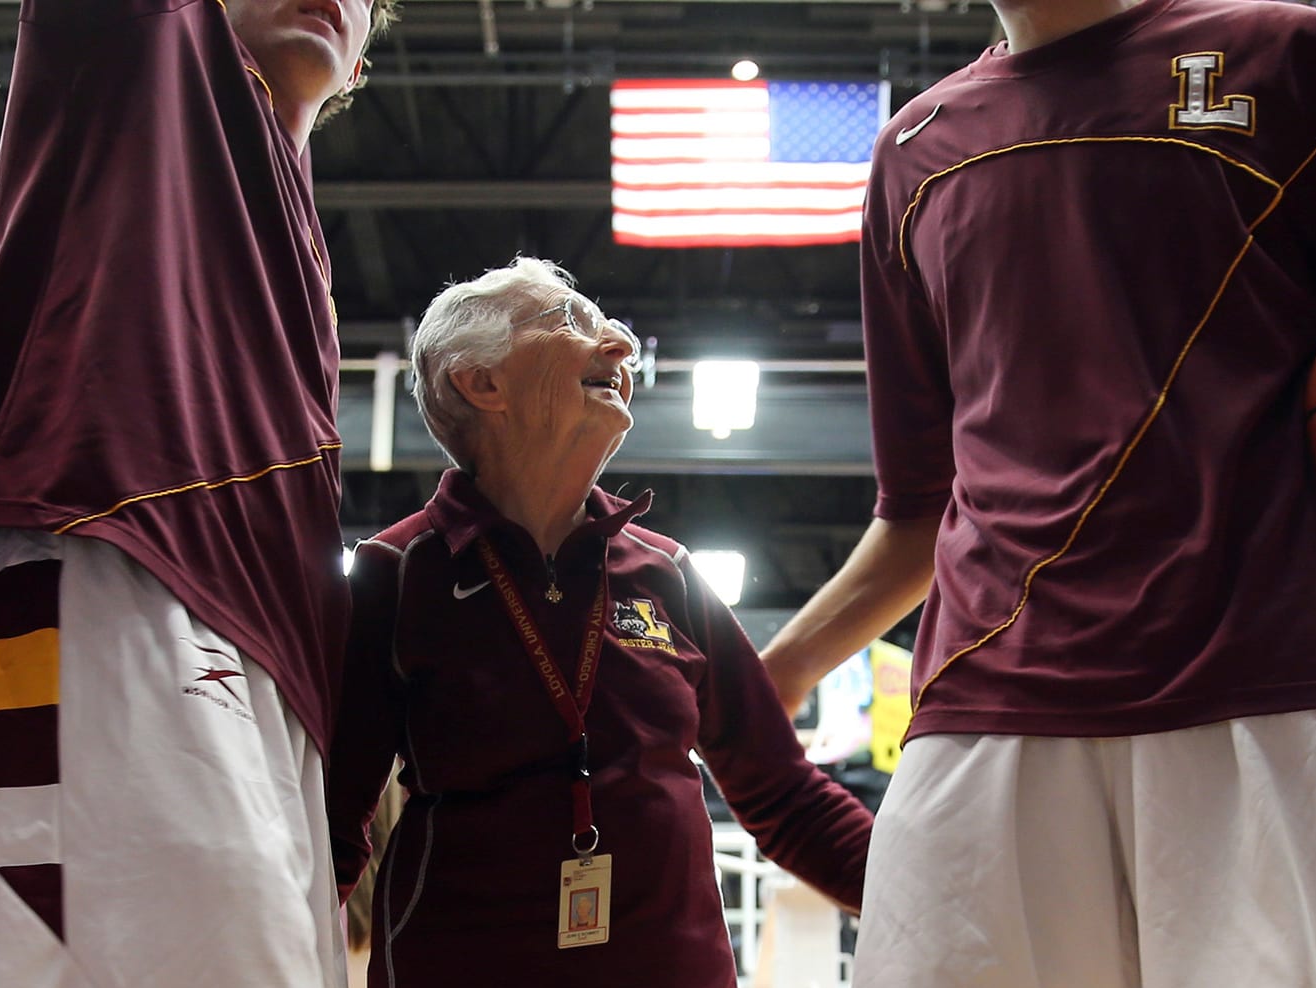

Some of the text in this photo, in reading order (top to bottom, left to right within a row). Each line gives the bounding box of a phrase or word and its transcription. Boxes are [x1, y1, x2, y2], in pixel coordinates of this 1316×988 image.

[1169, 51, 1256, 137] L
[494, 573, 538, 645] UNIVERSITY
[630, 598, 674, 646] L
[534, 644, 566, 699] LOYOLA
[578, 630, 599, 682] CHICAGO
